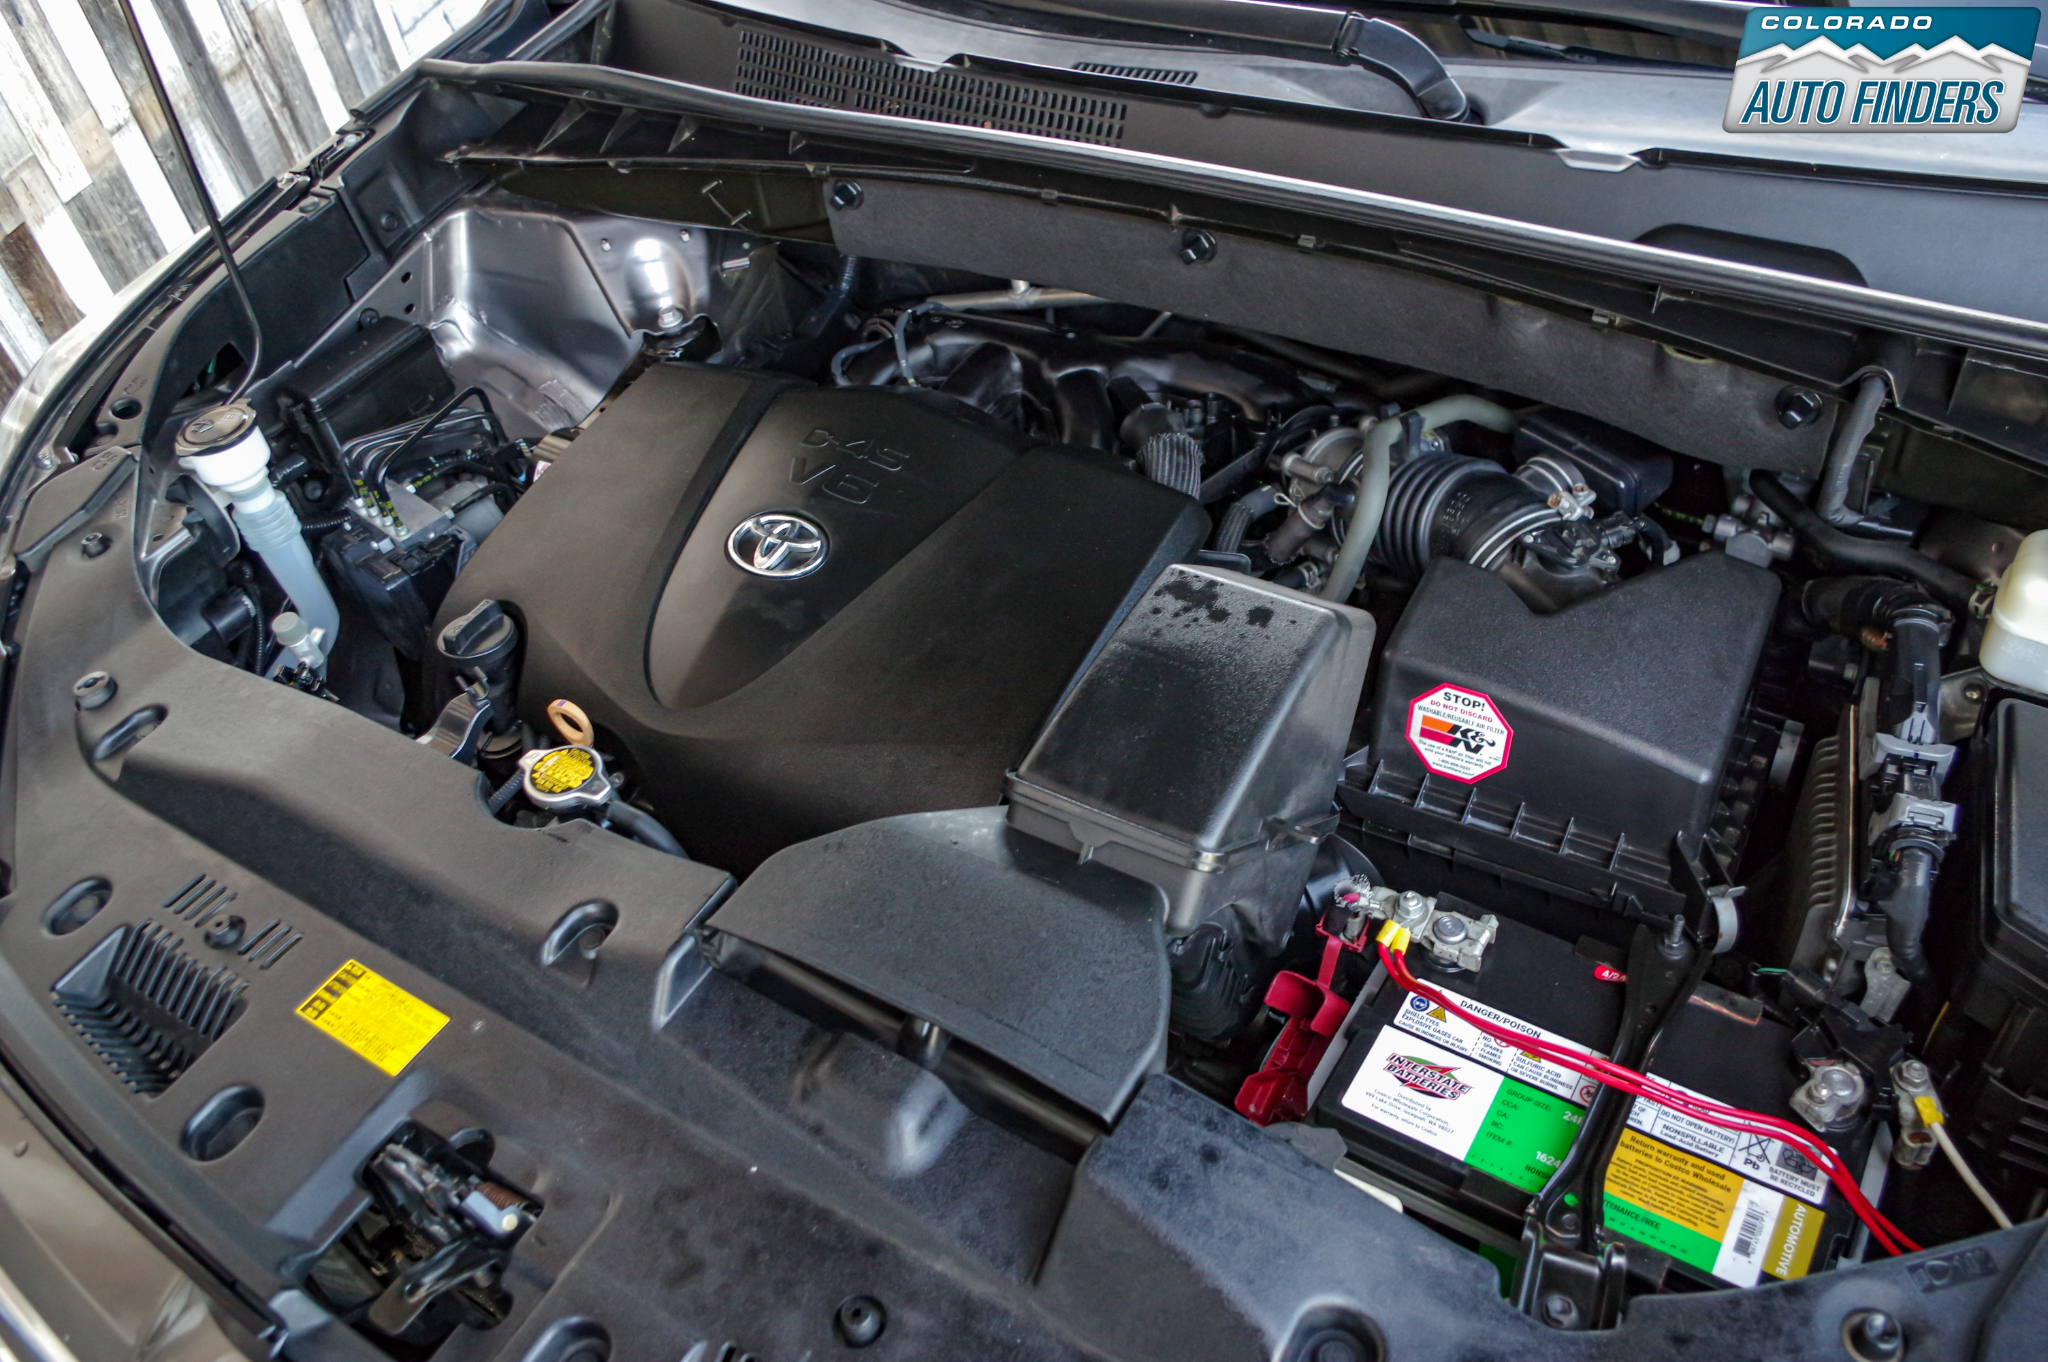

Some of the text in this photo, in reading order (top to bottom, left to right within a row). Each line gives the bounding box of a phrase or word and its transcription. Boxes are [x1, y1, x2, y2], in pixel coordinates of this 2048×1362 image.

[789, 456, 879, 504] V6
[1444, 692, 1485, 711] STOP!
[1418, 705, 1474, 726] WASHABLE/REUSABLE
[1486, 726, 1504, 734] FILTER
[1443, 704, 1458, 712] NOT
[1460, 709, 1493, 723] DISCARD
[1405, 1009, 1424, 1020] SHIELD
[1460, 1000, 1541, 1040] DANGER/POISON
[1398, 1020, 1414, 1029] CAUSE
[1415, 1027, 1441, 1041] BLINDNESS
[1401, 1013, 1463, 1044] EXPLOSIVE GASES CAN
[1482, 1035, 1491, 1043] NO
[1389, 1055, 1469, 1094] INTERSTATE
[1511, 1066, 1558, 1090] OR SEVERE BURNS.
[1516, 1056, 1561, 1078] SULFURIC ACID
[1525, 1067, 1542, 1077] CAUSE
[1544, 1075, 1573, 1090] BLINDNESS
[1387, 1063, 1458, 1098] BATTERIES
[1502, 1099, 1519, 1110] CCA:
[1507, 1089, 1533, 1102] GROUP
[1491, 1121, 1503, 1129] RC:
[1496, 1110, 1509, 1118] CA:
[1486, 1131, 1505, 1143] ITEM
[1663, 1124, 1724, 1153] NONSPILLABLE
[1671, 1114, 1684, 1123] NOT
[1686, 1120, 1703, 1130] OPEN
[1704, 1127, 1735, 1142] BATTERY!
[1660, 1130, 1719, 1158] Lead-Acid Battery
[1620, 1140, 1653, 1159] batteries
[1664, 1160, 1690, 1175] Costco
[1693, 1171, 1731, 1192] Wholesale
[1630, 1136, 1726, 1180] Return warranty and used
[1744, 1158, 1760, 1170] Pb
[1769, 1167, 1820, 1191] BATTERY MUST
[1780, 1178, 1815, 1197] RECYCLED
[1641, 1217, 1659, 1229] FREE
[1776, 1204, 1807, 1276] AUTOMOTIVE
